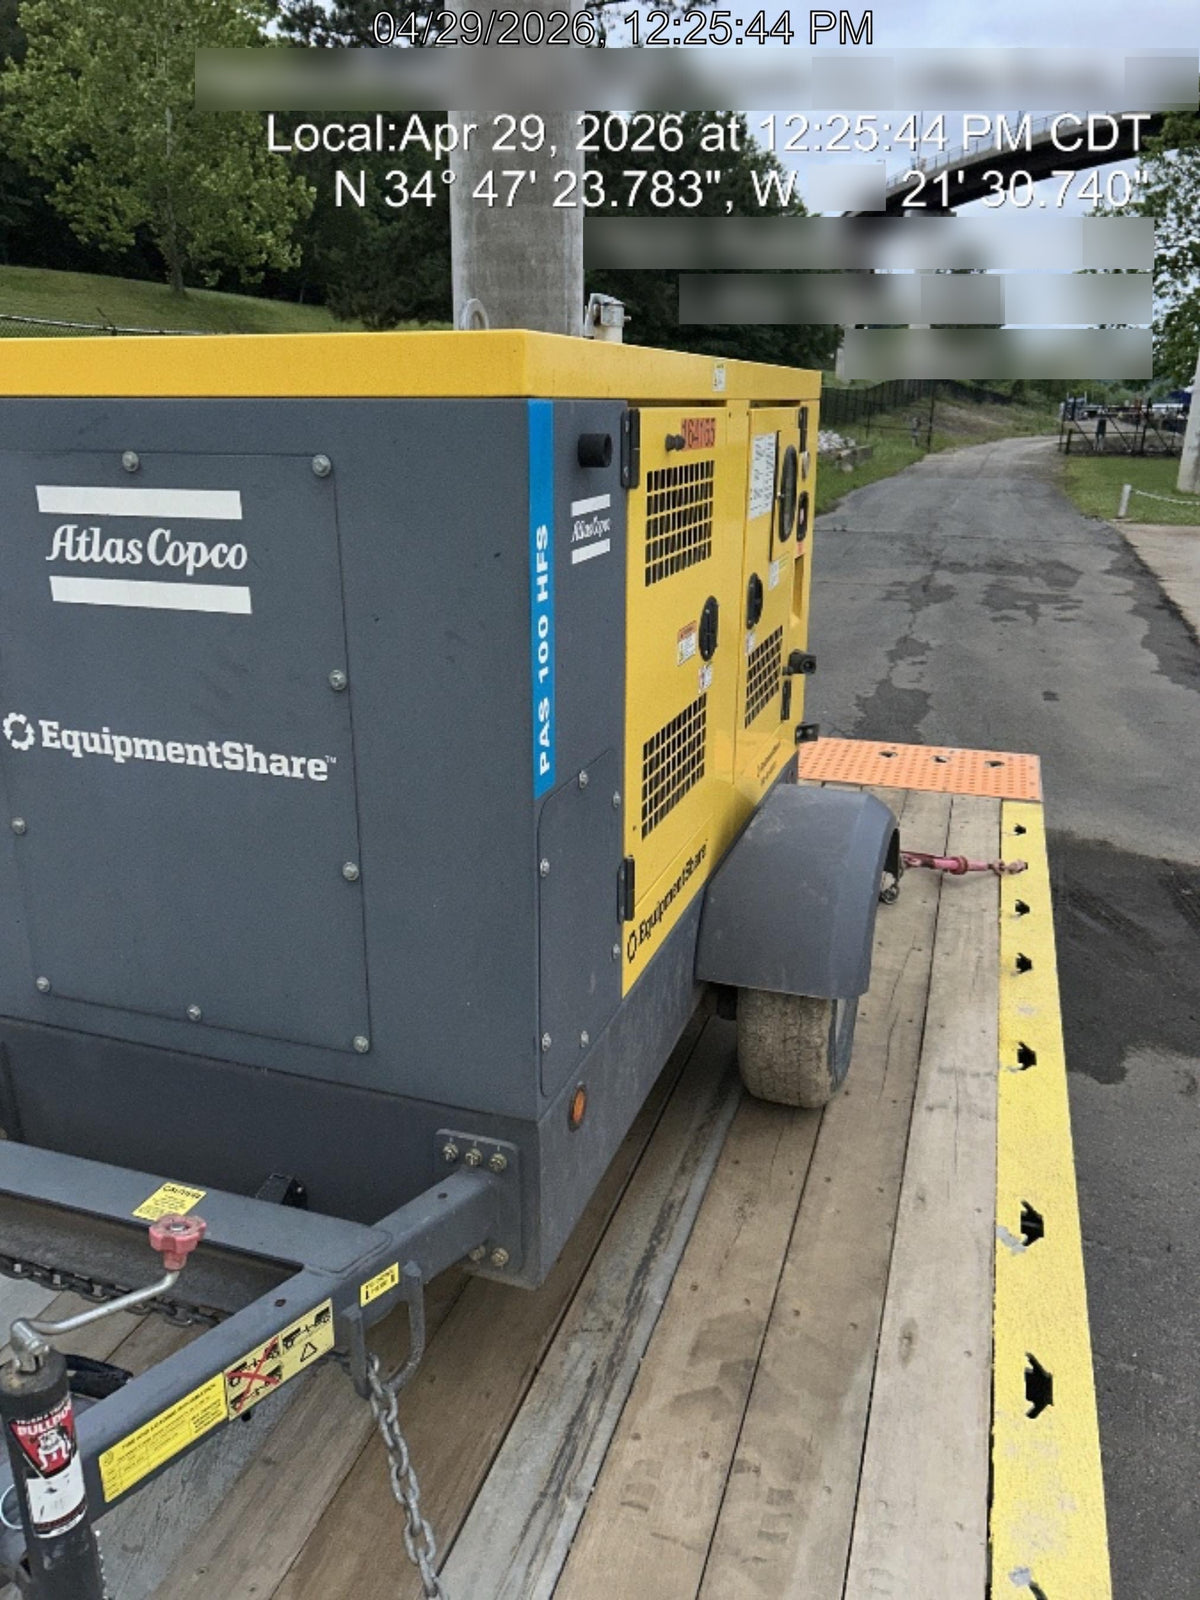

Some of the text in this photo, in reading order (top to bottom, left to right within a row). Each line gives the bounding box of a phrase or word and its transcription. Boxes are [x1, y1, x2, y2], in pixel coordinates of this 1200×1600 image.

[536, 524, 551, 776] PAS 100 HFS
